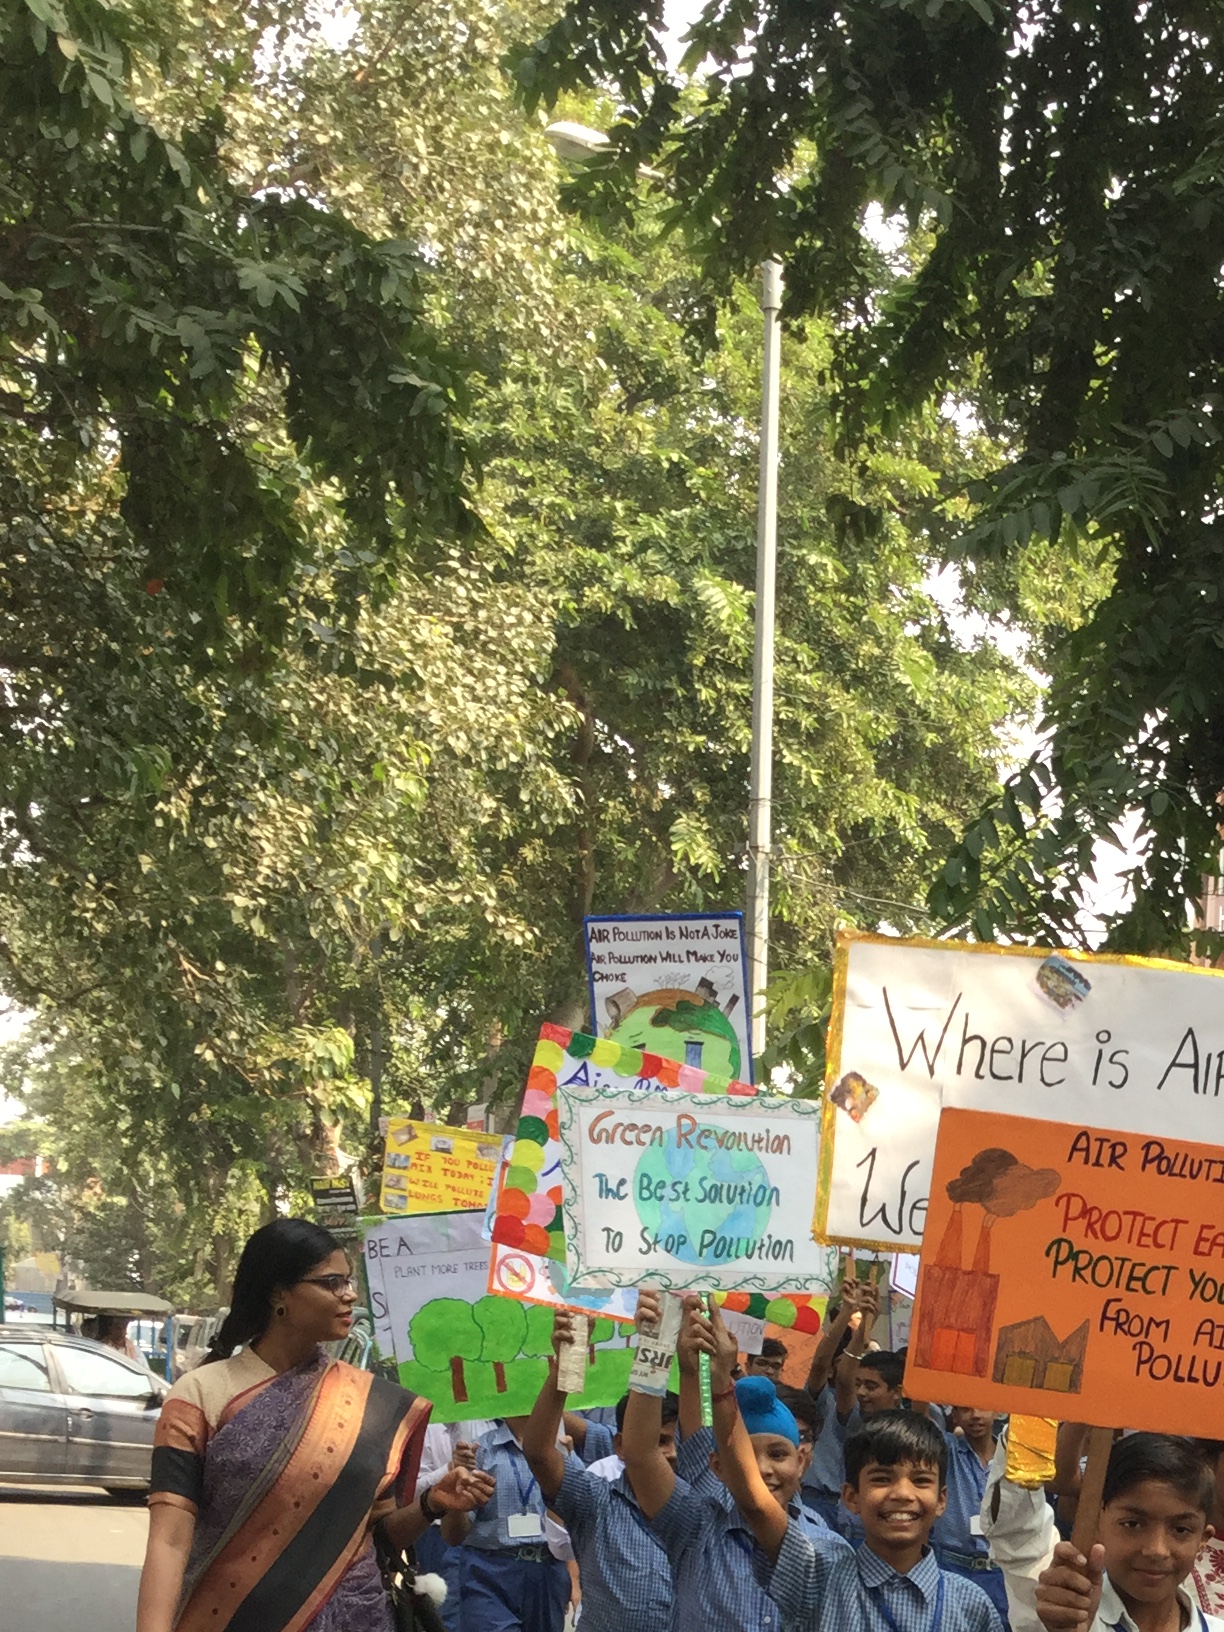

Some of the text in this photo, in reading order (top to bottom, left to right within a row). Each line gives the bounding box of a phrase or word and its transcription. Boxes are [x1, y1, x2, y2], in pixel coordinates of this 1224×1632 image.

[590, 927, 610, 943] AIR
[613, 926, 662, 942] POLLUTION
[711, 924, 738, 940] JOKE
[591, 949, 739, 965] AIR POLLUTION WILL MAKE YOU
[593, 970, 627, 983] CHOKE
[882, 986, 1069, 1088] Where
[1092, 1029, 1130, 1089] is
[588, 1110, 664, 1148] Green
[415, 1151, 431, 1161] IF
[1067, 1130, 1128, 1171] AIR
[410, 1162, 432, 1174] AIR
[441, 1168, 475, 1181] TODAY
[408, 1190, 443, 1203] LUNGS
[445, 1184, 484, 1198] POLLUTE
[593, 1172, 628, 1201] The
[638, 1172, 691, 1202] Best
[1054, 1192, 1190, 1252] PROTECT
[367, 1236, 414, 1260] BE A
[394, 1261, 489, 1279] PLANT MORE TREES
[1045, 1238, 1179, 1297] PROTECT
[1099, 1297, 1170, 1344] FROM
